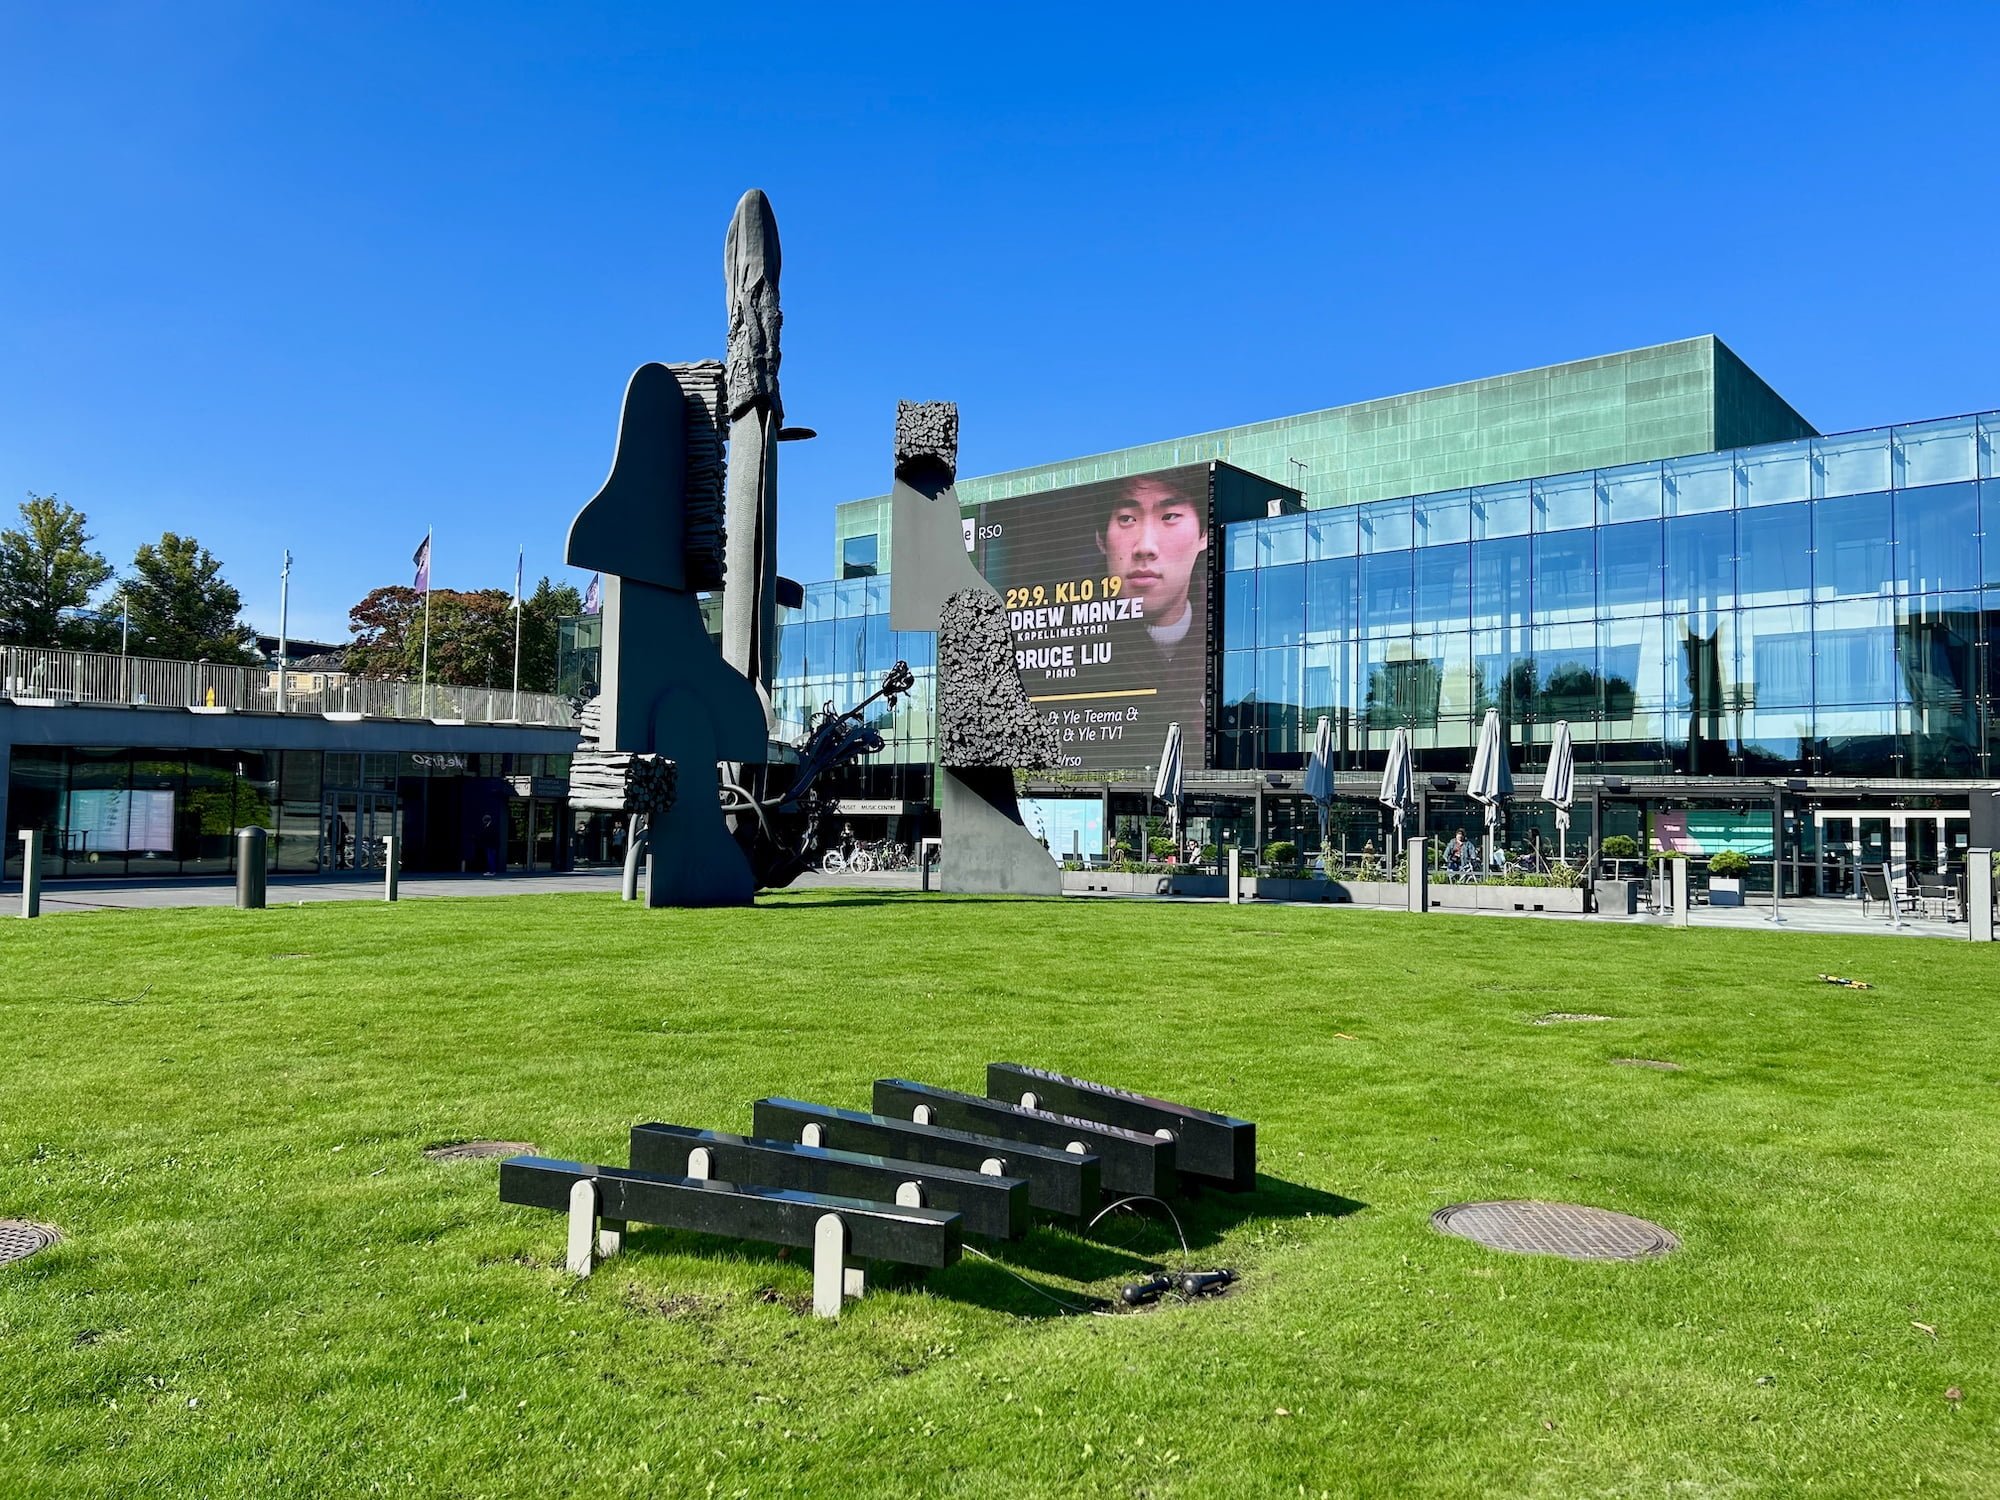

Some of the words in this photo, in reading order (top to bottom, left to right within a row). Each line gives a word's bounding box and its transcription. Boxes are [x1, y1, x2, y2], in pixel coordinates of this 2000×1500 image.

[978, 524, 1003, 540] RSO
[1006, 585, 1049, 609] 29.9.
[1055, 579, 1094, 604] KLO
[1100, 575, 1122, 598] 19
[1008, 606, 1065, 631] DREW
[1071, 596, 1144, 625] MANZE
[1017, 623, 1108, 642] KAPELLIMESTARI
[1015, 645, 1074, 670] BRUCE
[1081, 642, 1112, 665] LIU
[1045, 667, 1077, 679] PIANO
[1063, 709, 1080, 725] Yle
[1084, 709, 1122, 723] Teema
[1126, 706, 1139, 721] &
[1063, 727, 1075, 742] &
[1078, 726, 1096, 741] Yle
[1100, 726, 1123, 740] TV1
[1061, 754, 1082, 767] /rso
